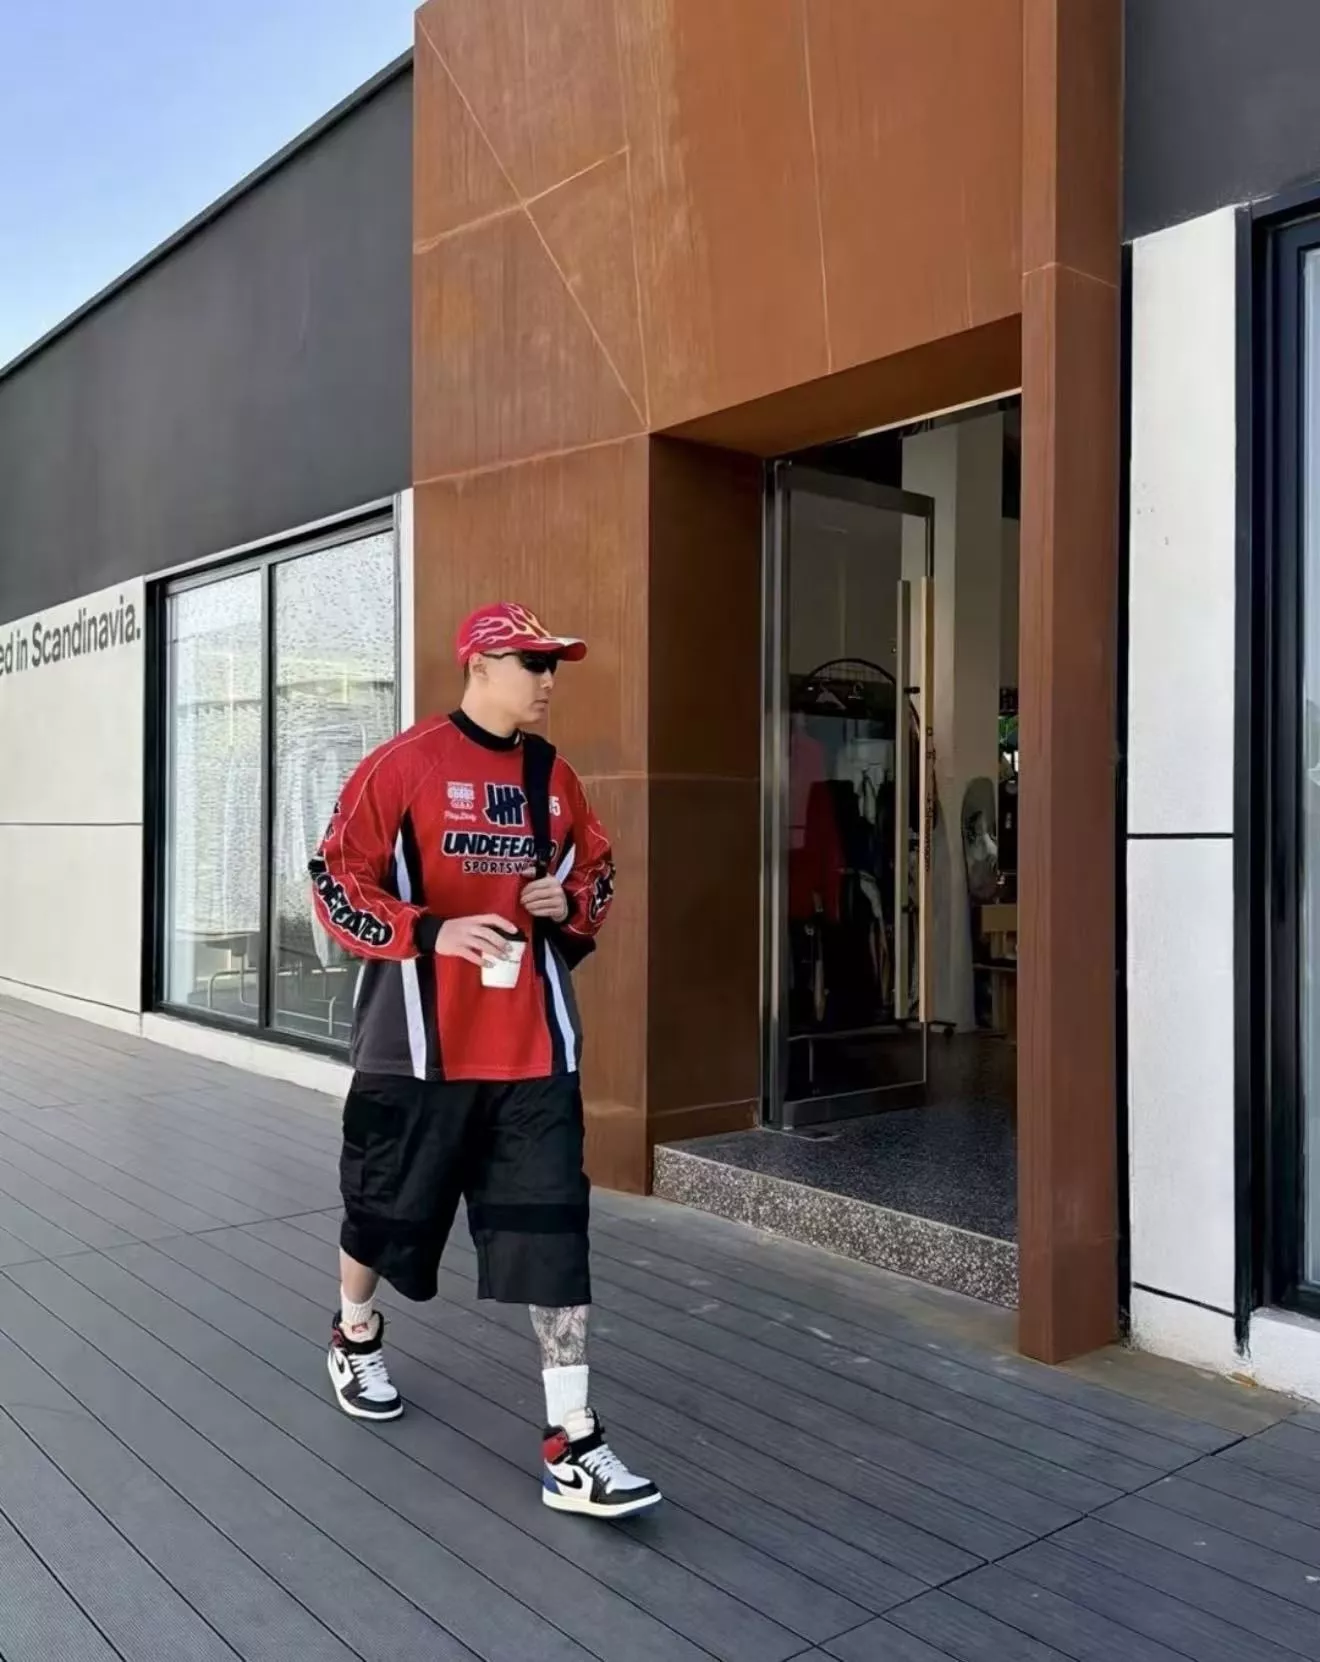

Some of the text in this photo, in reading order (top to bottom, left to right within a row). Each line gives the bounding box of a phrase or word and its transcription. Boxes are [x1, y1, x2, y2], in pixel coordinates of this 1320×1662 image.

[16, 629, 28, 672] in
[31, 594, 142, 668] Scandinavia.
[463, 860, 530, 875] SPORTSW
